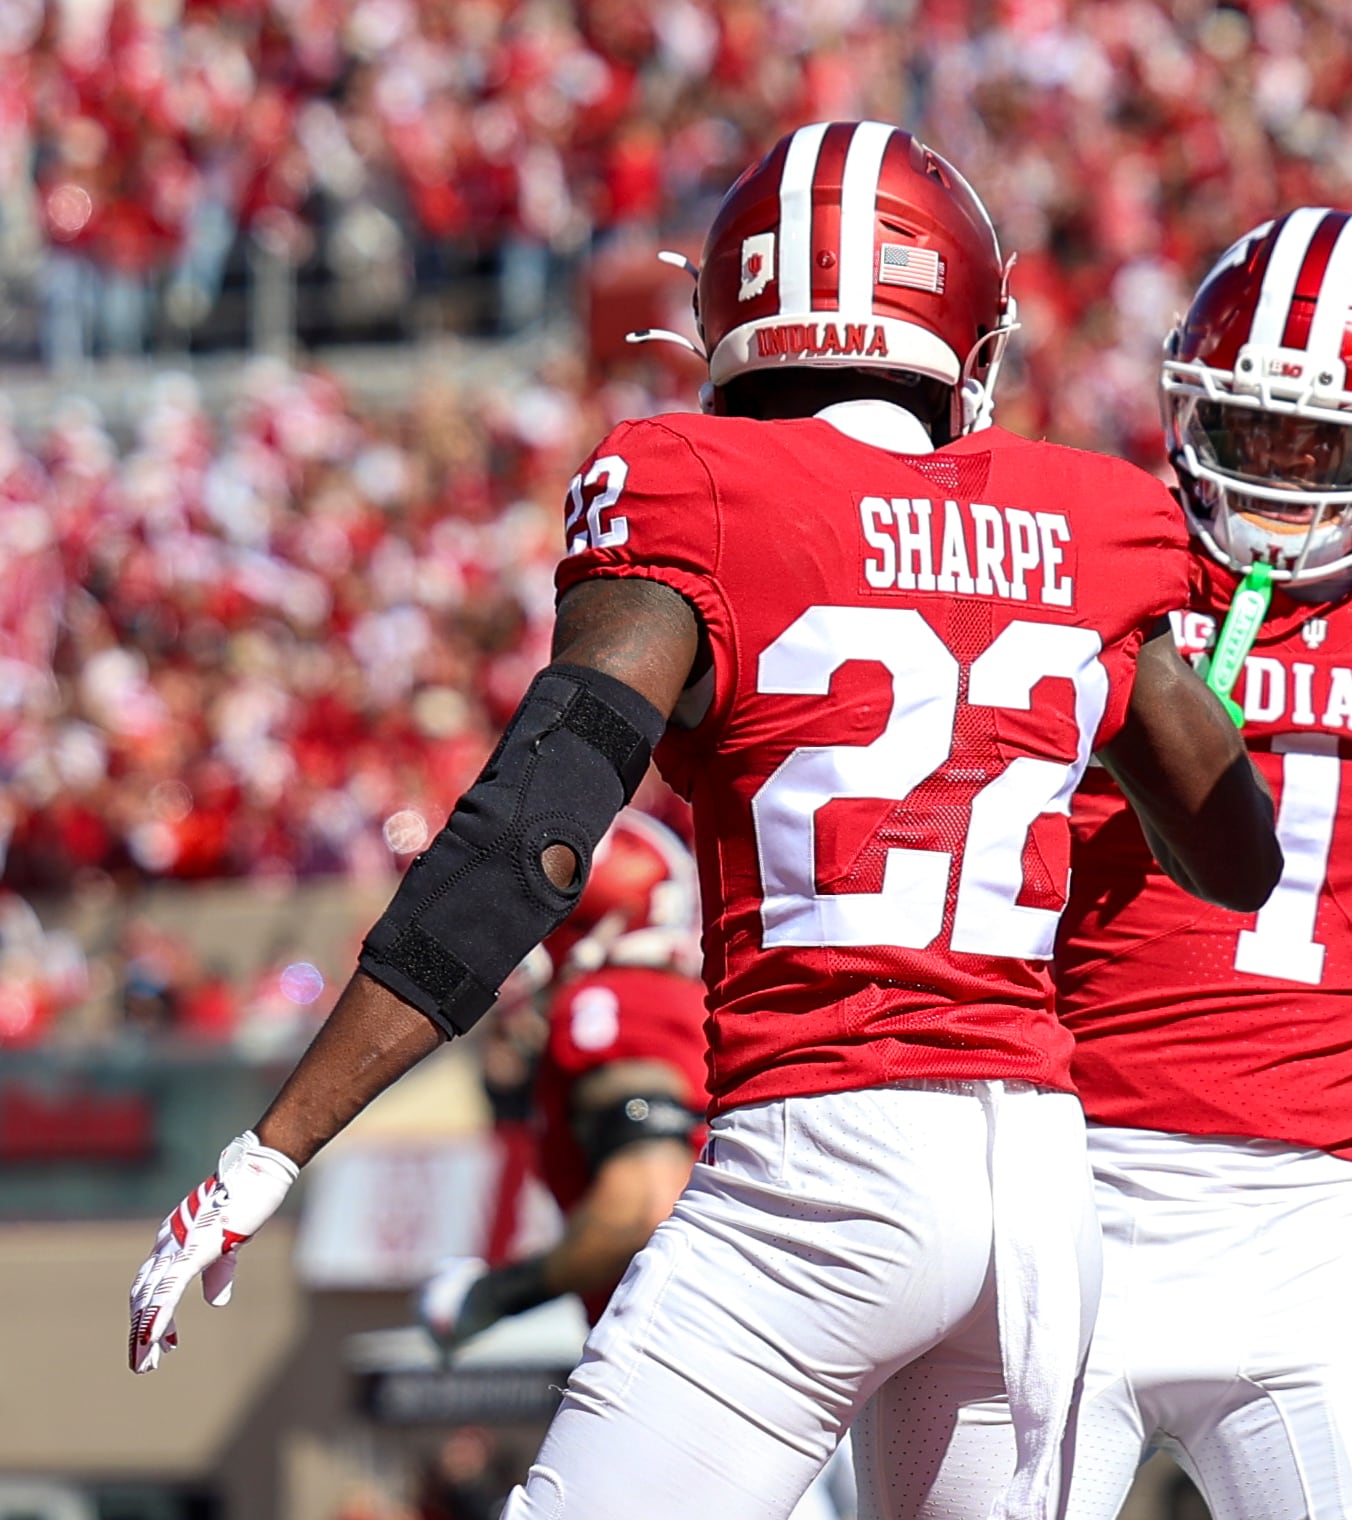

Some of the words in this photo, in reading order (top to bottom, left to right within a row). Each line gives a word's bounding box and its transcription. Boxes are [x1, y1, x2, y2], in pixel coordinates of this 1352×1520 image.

[755, 322, 889, 357] INDIANA
[859, 496, 1073, 606] SHARPE
[752, 604, 1110, 961] 22
[1234, 732, 1341, 986] 1
